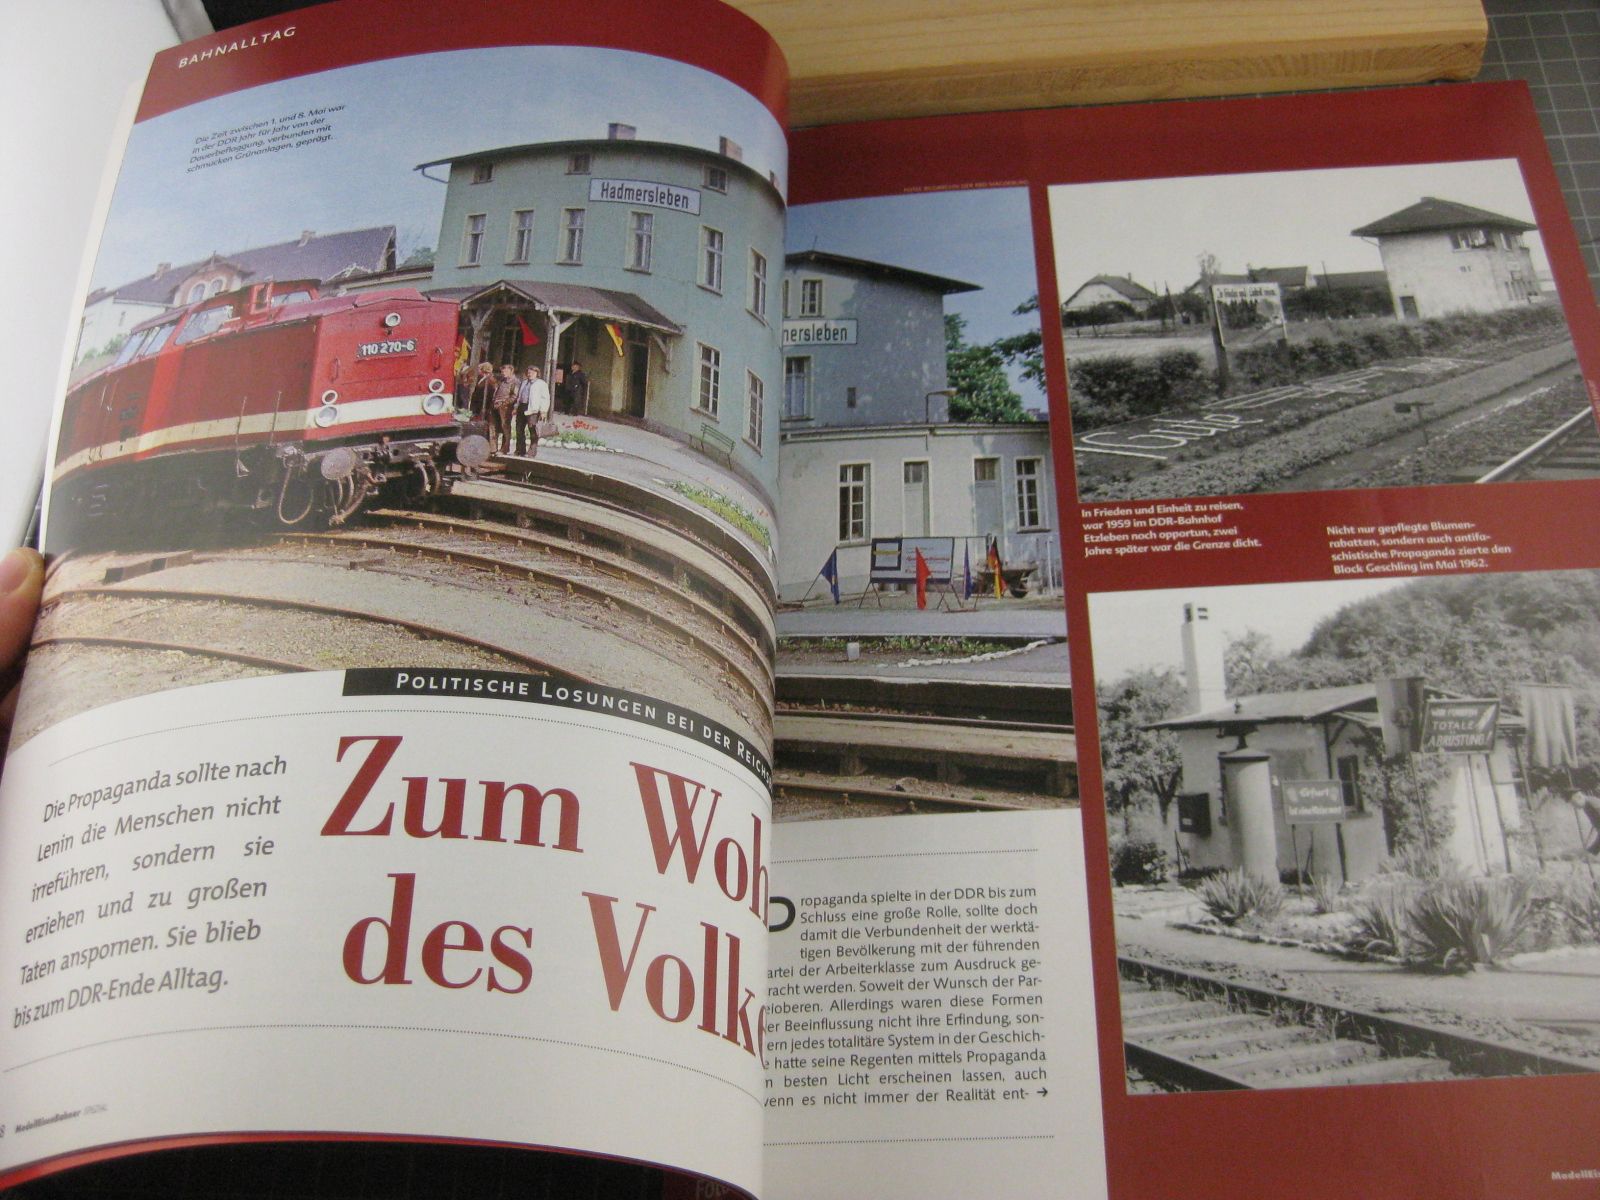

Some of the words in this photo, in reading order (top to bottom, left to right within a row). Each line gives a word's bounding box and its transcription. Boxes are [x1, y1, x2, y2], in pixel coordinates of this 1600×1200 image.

[178, 26, 296, 69] BAHNALLTAG
[230, 121, 268, 135] zwischen
[279, 113, 296, 123] und
[217, 137, 237, 147] DDR
[268, 129, 314, 143] verbunden
[600, 182, 689, 210] Hadmersleben
[362, 344, 378, 355] 110
[1082, 509, 1091, 518] In
[1094, 508, 1132, 517] Frieden
[1135, 506, 1154, 515] und
[1157, 504, 1192, 514] Einheit
[1195, 504, 1207, 512] zu
[1209, 502, 1243, 511] reisen,
[1106, 520, 1130, 528] 1959
[1133, 518, 1146, 527] im
[1149, 514, 1222, 526] DDR-Bahnhof
[1327, 525, 1354, 535] Nicht
[1358, 526, 1375, 534] nur
[1378, 523, 1428, 536] gepflegte
[1431, 521, 1475, 531] Blumen-
[1084, 533, 1128, 543] Etzleben
[1132, 531, 1157, 540] noch
[1159, 528, 1211, 541] opportun,
[1213, 526, 1237, 536] zwei
[1330, 537, 1379, 547] rabatten,
[1382, 536, 1424, 546] sondern
[1427, 534, 1452, 543] auch
[1455, 532, 1490, 542] antifa-
[1084, 546, 1112, 558] Jahre
[1115, 544, 1148, 556] später
[1151, 544, 1172, 552] war
[1174, 542, 1190, 551] die
[1193, 540, 1230, 550] Grenze
[1233, 538, 1262, 548] dicht.
[1332, 551, 1387, 561] schistische
[1390, 548, 1455, 561] Propaganda
[1458, 545, 1488, 555] zierte
[1491, 544, 1512, 553] den
[1334, 564, 1363, 574] Block
[1366, 562, 1417, 574] Geschling
[1420, 561, 1434, 569] im
[1436, 560, 1456, 569] Mai
[1461, 559, 1488, 568] 1962.
[667, 712, 694, 733] BEI
[703, 725, 731, 750] DER
[44, 801, 65, 823] Die
[69, 771, 171, 812] Propaganda
[176, 763, 230, 786] sollte
[236, 755, 286, 779] nach
[38, 835, 74, 862] Lenin
[81, 824, 107, 846] die
[114, 804, 214, 836] Menschen
[226, 795, 281, 818] nicht
[320, 735, 584, 853] Zum
[629, 761, 769, 927] Woh
[32, 862, 109, 902] irreführen,
[132, 844, 214, 871] sondern
[244, 836, 274, 856] sie
[871, 890, 911, 905] spielte
[915, 890, 926, 900] in
[930, 889, 951, 900] der
[955, 889, 985, 899] DDR
[989, 887, 1006, 898] bis
[1010, 888, 1036, 898] zum
[26, 908, 84, 944] erziehen
[98, 892, 133, 919] und
[148, 890, 171, 908] zu
[187, 878, 267, 909] großen
[801, 910, 846, 923] Schluss
[852, 910, 878, 921] eine
[884, 908, 920, 923] große
[926, 907, 961, 919] Rolle,
[966, 904, 999, 918] sollte
[1004, 903, 1038, 916] doch
[342, 873, 533, 994] des
[801, 928, 837, 941] damit
[841, 927, 860, 939] die
[865, 924, 961, 938] Verbundenheit
[966, 922, 986, 934] der
[990, 921, 1039, 933] werktä-
[20, 956, 55, 985] Taten
[60, 934, 158, 970] anspornen.
[166, 925, 197, 948] Sie
[206, 919, 261, 944] blieb
[800, 948, 830, 962] tigen
[836, 943, 916, 958] Bevölkerung
[921, 942, 942, 954] mit
[947, 941, 968, 953] der
[972, 939, 1039, 952] führenden
[799, 965, 820, 977] der
[826, 961, 915, 975] Arbeiterklasse
[921, 962, 948, 971] zum
[954, 958, 1015, 970] Ausdruck
[1022, 959, 1041, 971] ge-
[804, 981, 856, 994] werden.
[860, 980, 903, 992] Soweit
[908, 978, 929, 990] der
[934, 976, 987, 990] Wunsch
[992, 975, 1013, 988] der
[1018, 974, 1042, 986] Par-
[14, 1008, 31, 1029] bis
[33, 997, 64, 1021] zum
[68, 973, 154, 1010] DDR-Ende
[158, 968, 228, 993] Alltag.
[830, 999, 893, 1013] Allerdings
[902, 998, 941, 1008] waren
[950, 995, 984, 1007] diese
[992, 994, 1042, 1006] Formen
[784, 1016, 873, 1031] Beeinflussung
[878, 1016, 911, 1028] nicht
[916, 1014, 940, 1026] ihre
[946, 1012, 1011, 1028] Erfindung,
[1016, 1012, 1044, 1024] son-
[791, 1035, 824, 1054] jedes
[828, 1034, 884, 1048] totalitäre
[888, 1033, 934, 1049] System
[939, 1032, 949, 1044] in
[954, 1031, 974, 1044] der
[979, 1029, 1045, 1043] Geschich-
[774, 1056, 807, 1069] hatte
[811, 1055, 845, 1067] seine
[850, 1053, 913, 1068] Regenten
[918, 1051, 962, 1064] mittels
[967, 1050, 1046, 1065] Propaganda
[784, 1074, 827, 1087] besten
[838, 1073, 869, 1086] Licht
[879, 1071, 951, 1084] erscheinen
[962, 1069, 1005, 1084] lassen,
[1014, 1068, 1047, 1080] auch
[802, 1095, 816, 1106] es
[823, 1091, 856, 1104] nicht
[864, 1091, 908, 1103] immer
[916, 1090, 938, 1102] der
[946, 1088, 995, 1101] Realität
[1003, 1089, 1029, 1100] ent-
